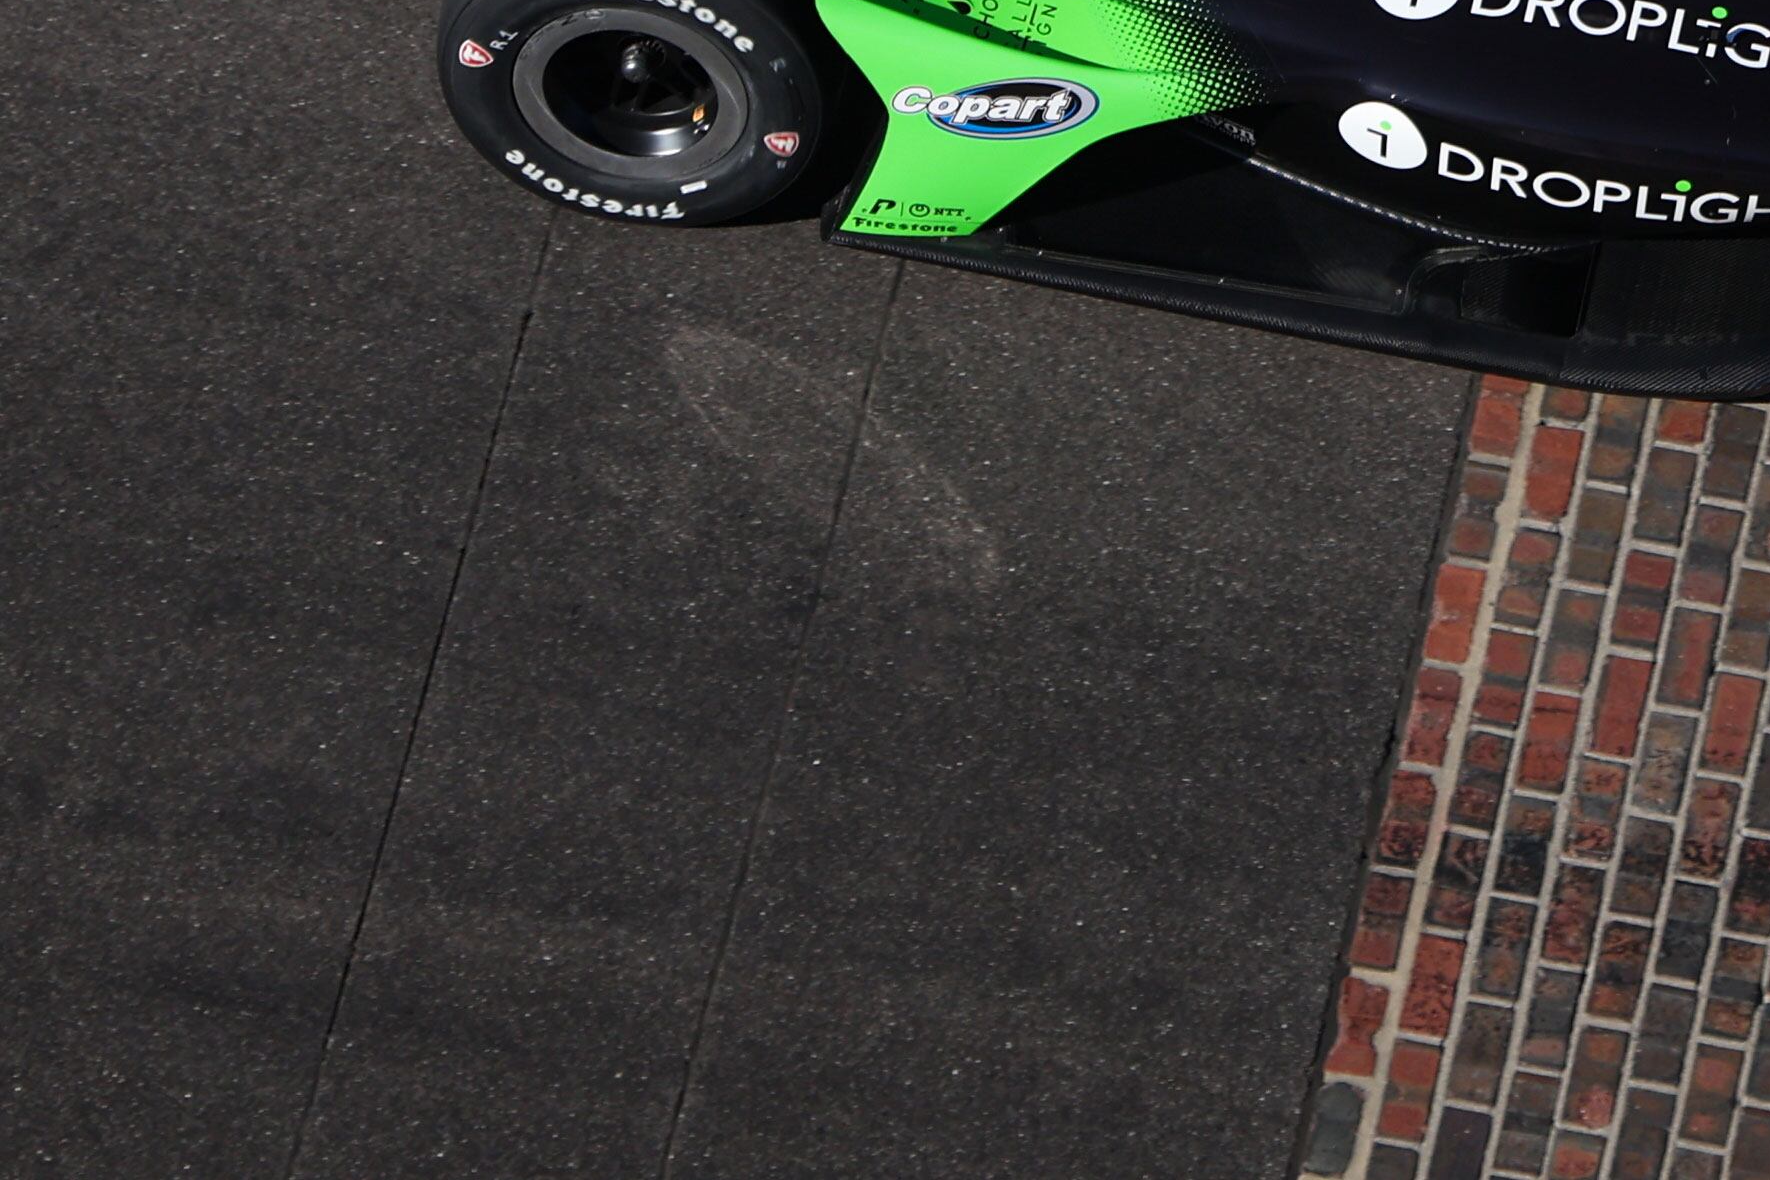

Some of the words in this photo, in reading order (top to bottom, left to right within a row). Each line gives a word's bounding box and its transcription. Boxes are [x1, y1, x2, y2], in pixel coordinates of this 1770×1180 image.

[1007, 0, 1033, 39] ALL
[892, 85, 1074, 125] Copart
[505, 149, 687, 220] Firestone
[852, 216, 958, 233] Firestone
[933, 207, 965, 217] NTT
